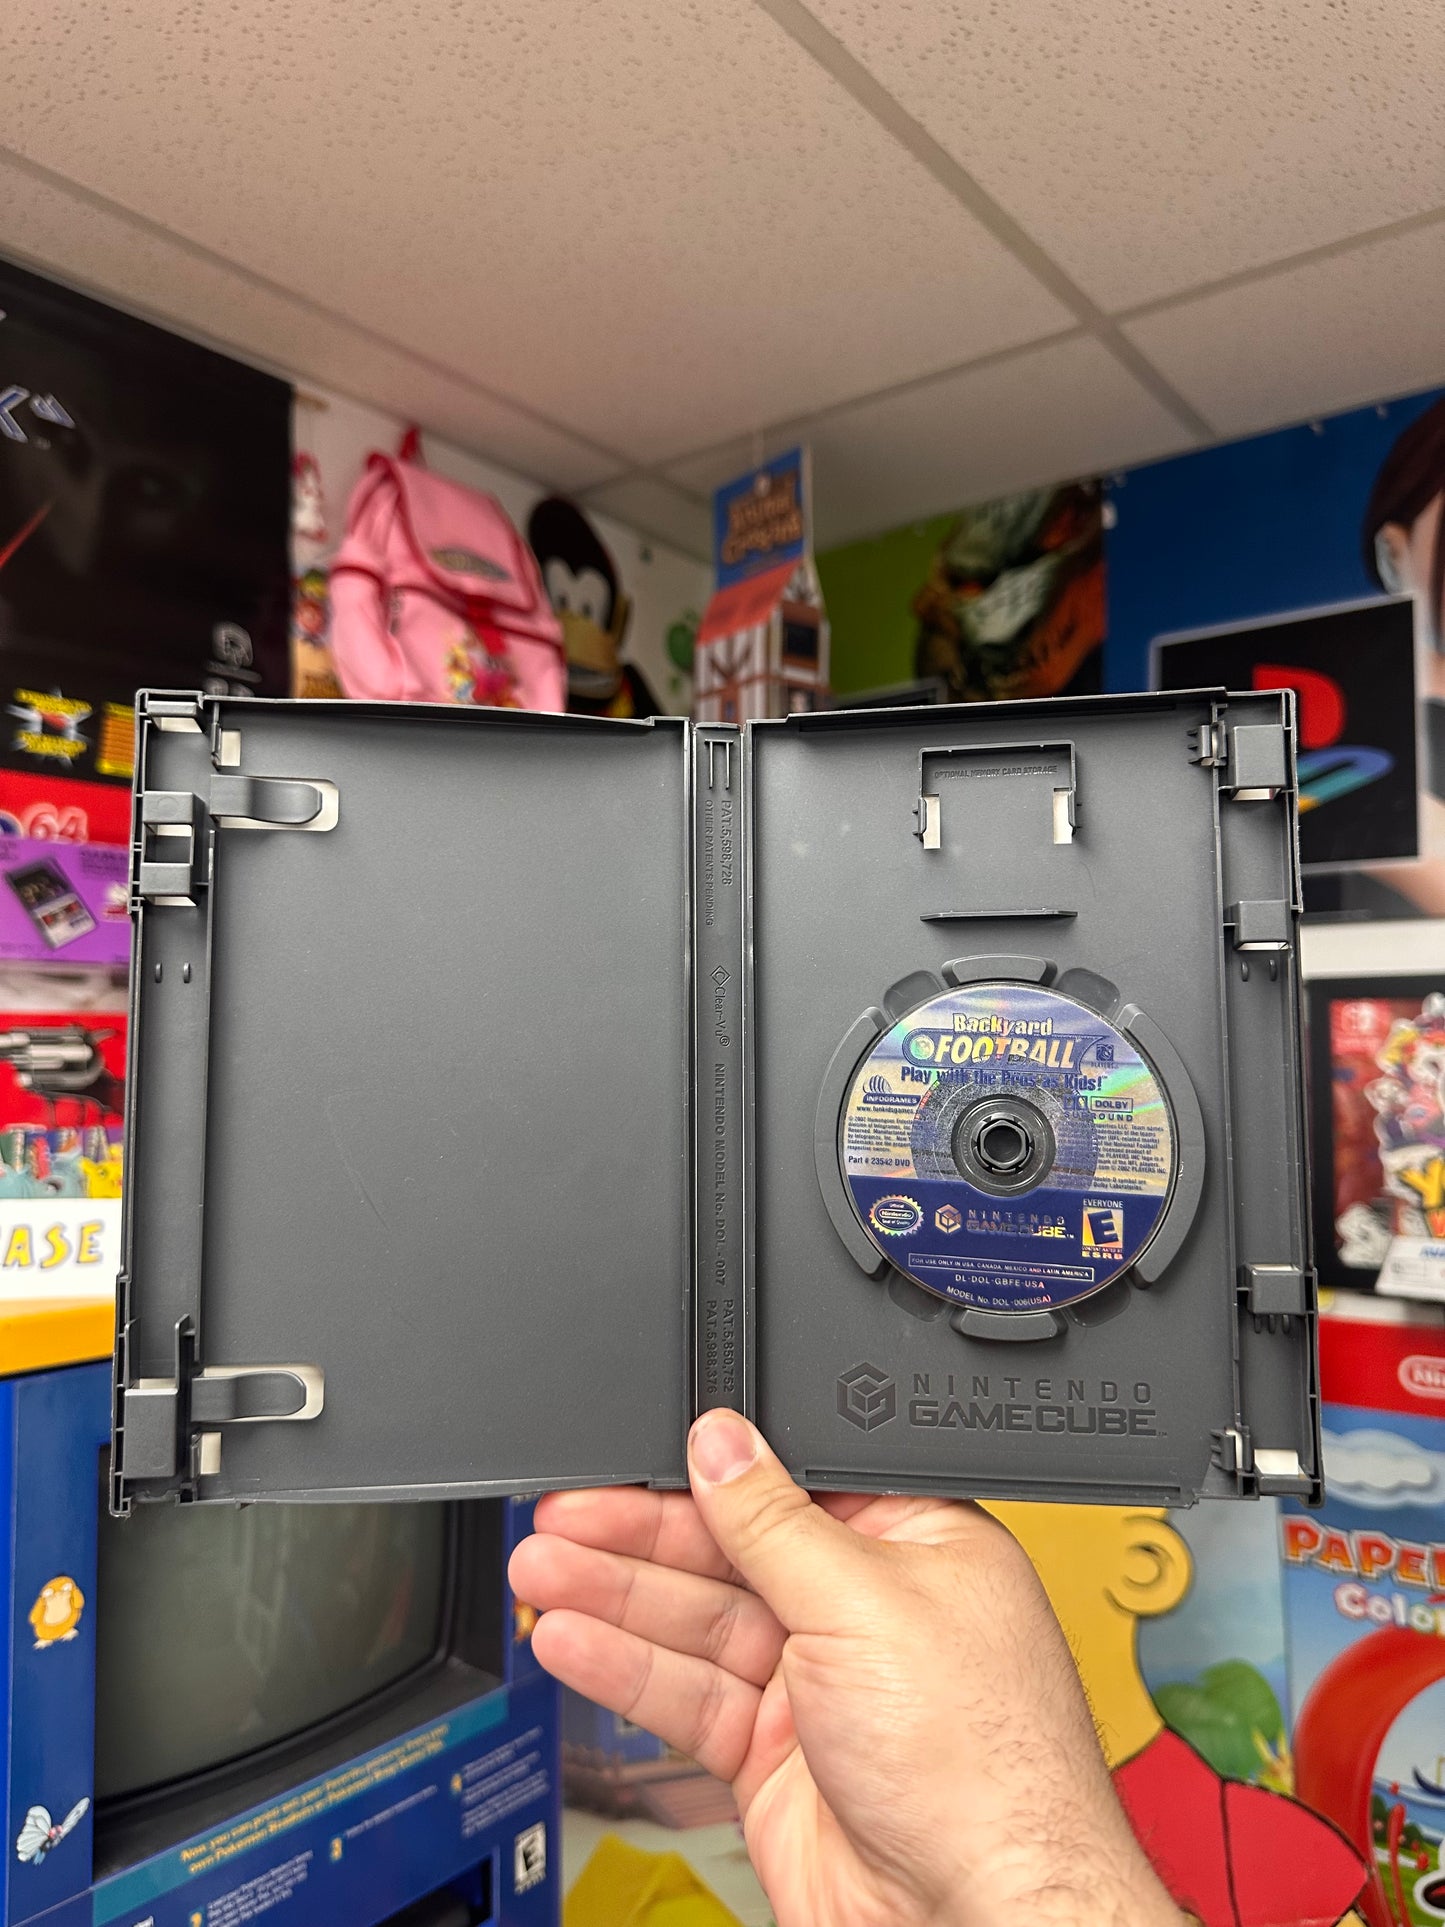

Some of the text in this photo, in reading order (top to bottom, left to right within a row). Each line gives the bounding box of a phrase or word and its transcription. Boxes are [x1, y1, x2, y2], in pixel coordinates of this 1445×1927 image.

[935, 765, 1058, 779] OPTIONAL MEMORY CARD STORAGE
[704, 800, 714, 926] OTHER PATENTS PENDING
[953, 1013, 1053, 1036] Backyard
[933, 1035, 1077, 1069] FOOTBALL
[901, 1066, 932, 1085] Play
[937, 1068, 971, 1084] with
[974, 1069, 996, 1085] the
[1000, 1071, 1035, 1087] Pros
[1042, 1076, 1058, 1088] as
[714, 1063, 725, 1137] NINTENDO
[1095, 1100, 1128, 1109] DOLBY
[715, 1139, 726, 1189] MODEL
[848, 1155, 863, 1164] Part
[895, 1159, 910, 1167] DVD
[1083, 1198, 1124, 1208] EVERYONE
[968, 1209, 1065, 1226] NINTENDO
[1087, 1209, 1120, 1245] E
[1081, 1251, 1123, 1260] ESRB
[1004, 1264, 1027, 1272] MEXICO
[1061, 1269, 1089, 1277] AMERICA
[955, 1273, 1046, 1289] DL-DOL-GBFE-USA
[946, 1285, 975, 1302] MODEL
[913, 1373, 1151, 1404] NINTENDO
